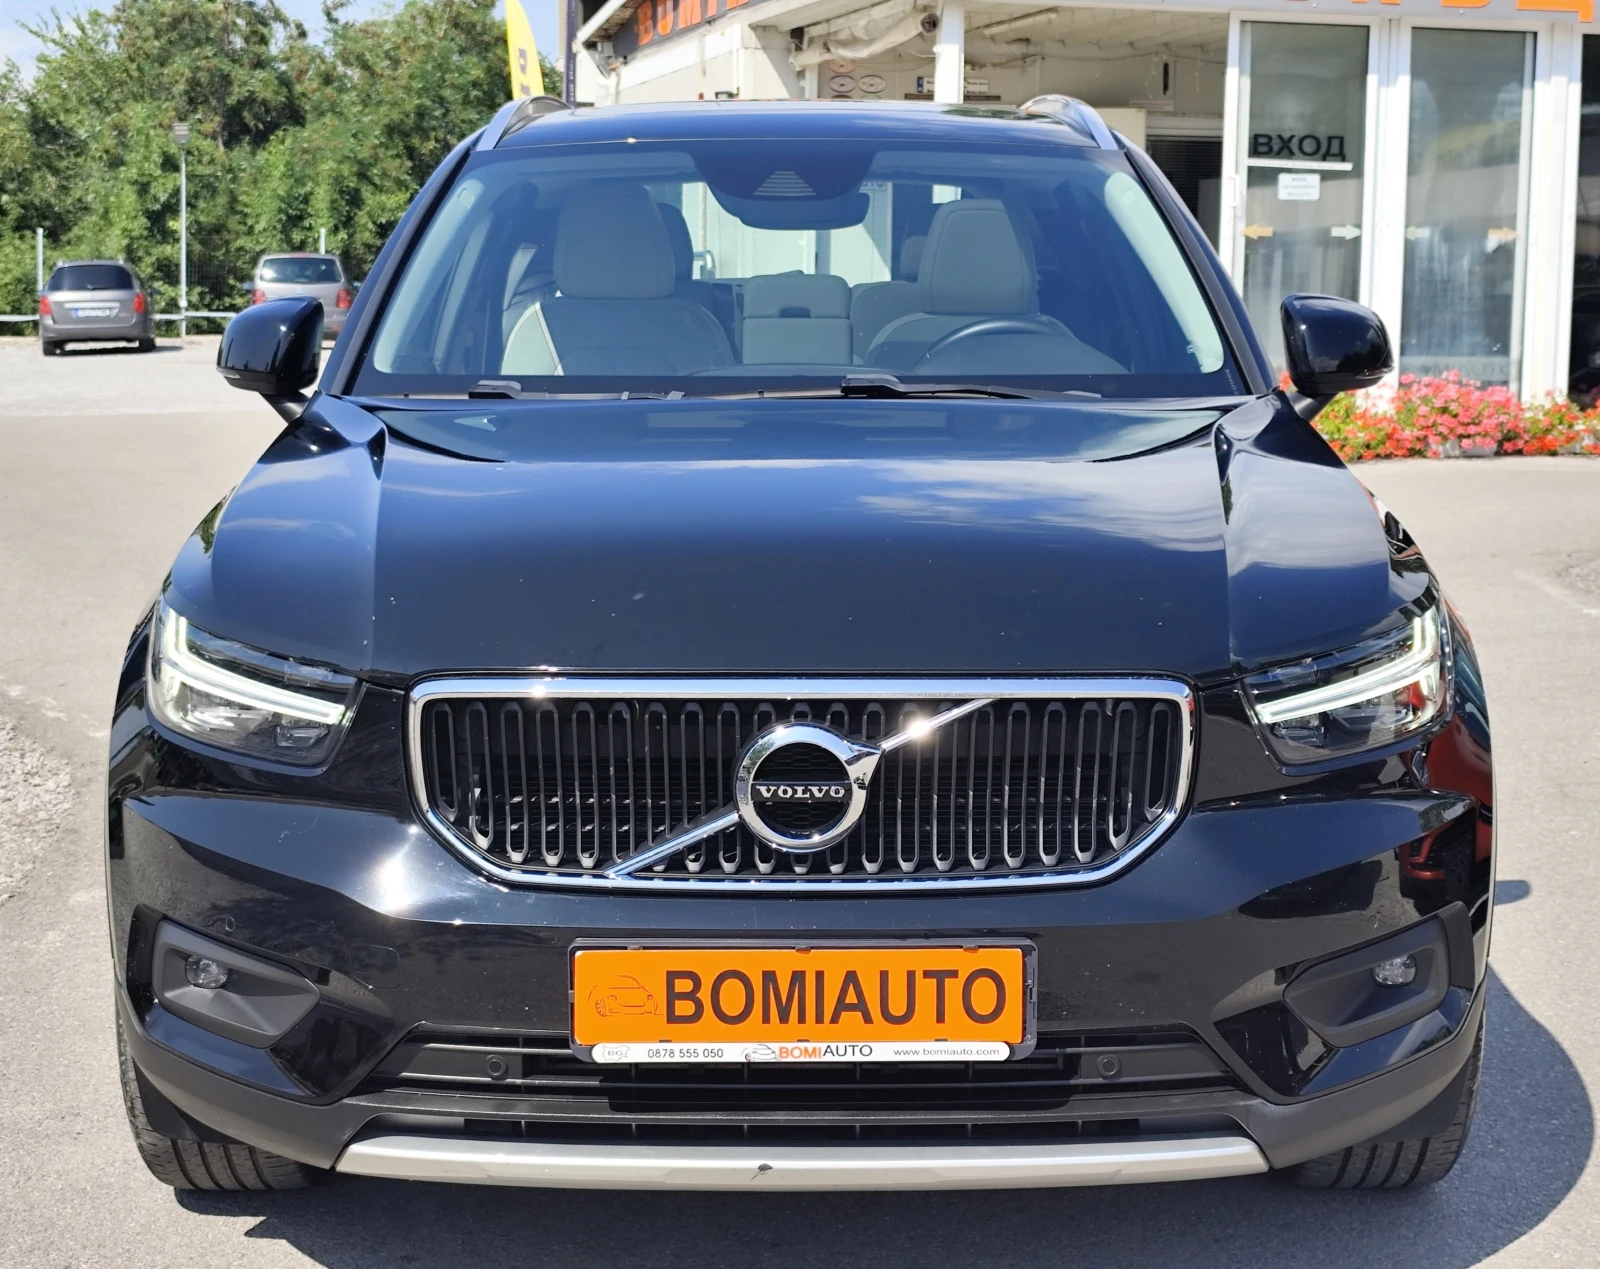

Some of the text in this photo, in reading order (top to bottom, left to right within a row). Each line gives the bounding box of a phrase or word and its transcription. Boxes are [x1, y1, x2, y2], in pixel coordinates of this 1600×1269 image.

[1252, 133, 1346, 162] ВХОД
[755, 785, 846, 799] VOLVO
[665, 968, 1006, 1026] BOMIAUTO
[647, 1048, 675, 1059] 0878
[679, 1048, 700, 1059] 555
[702, 1048, 724, 1059] 050
[893, 1047, 1000, 1056] www.bomiauto.com
